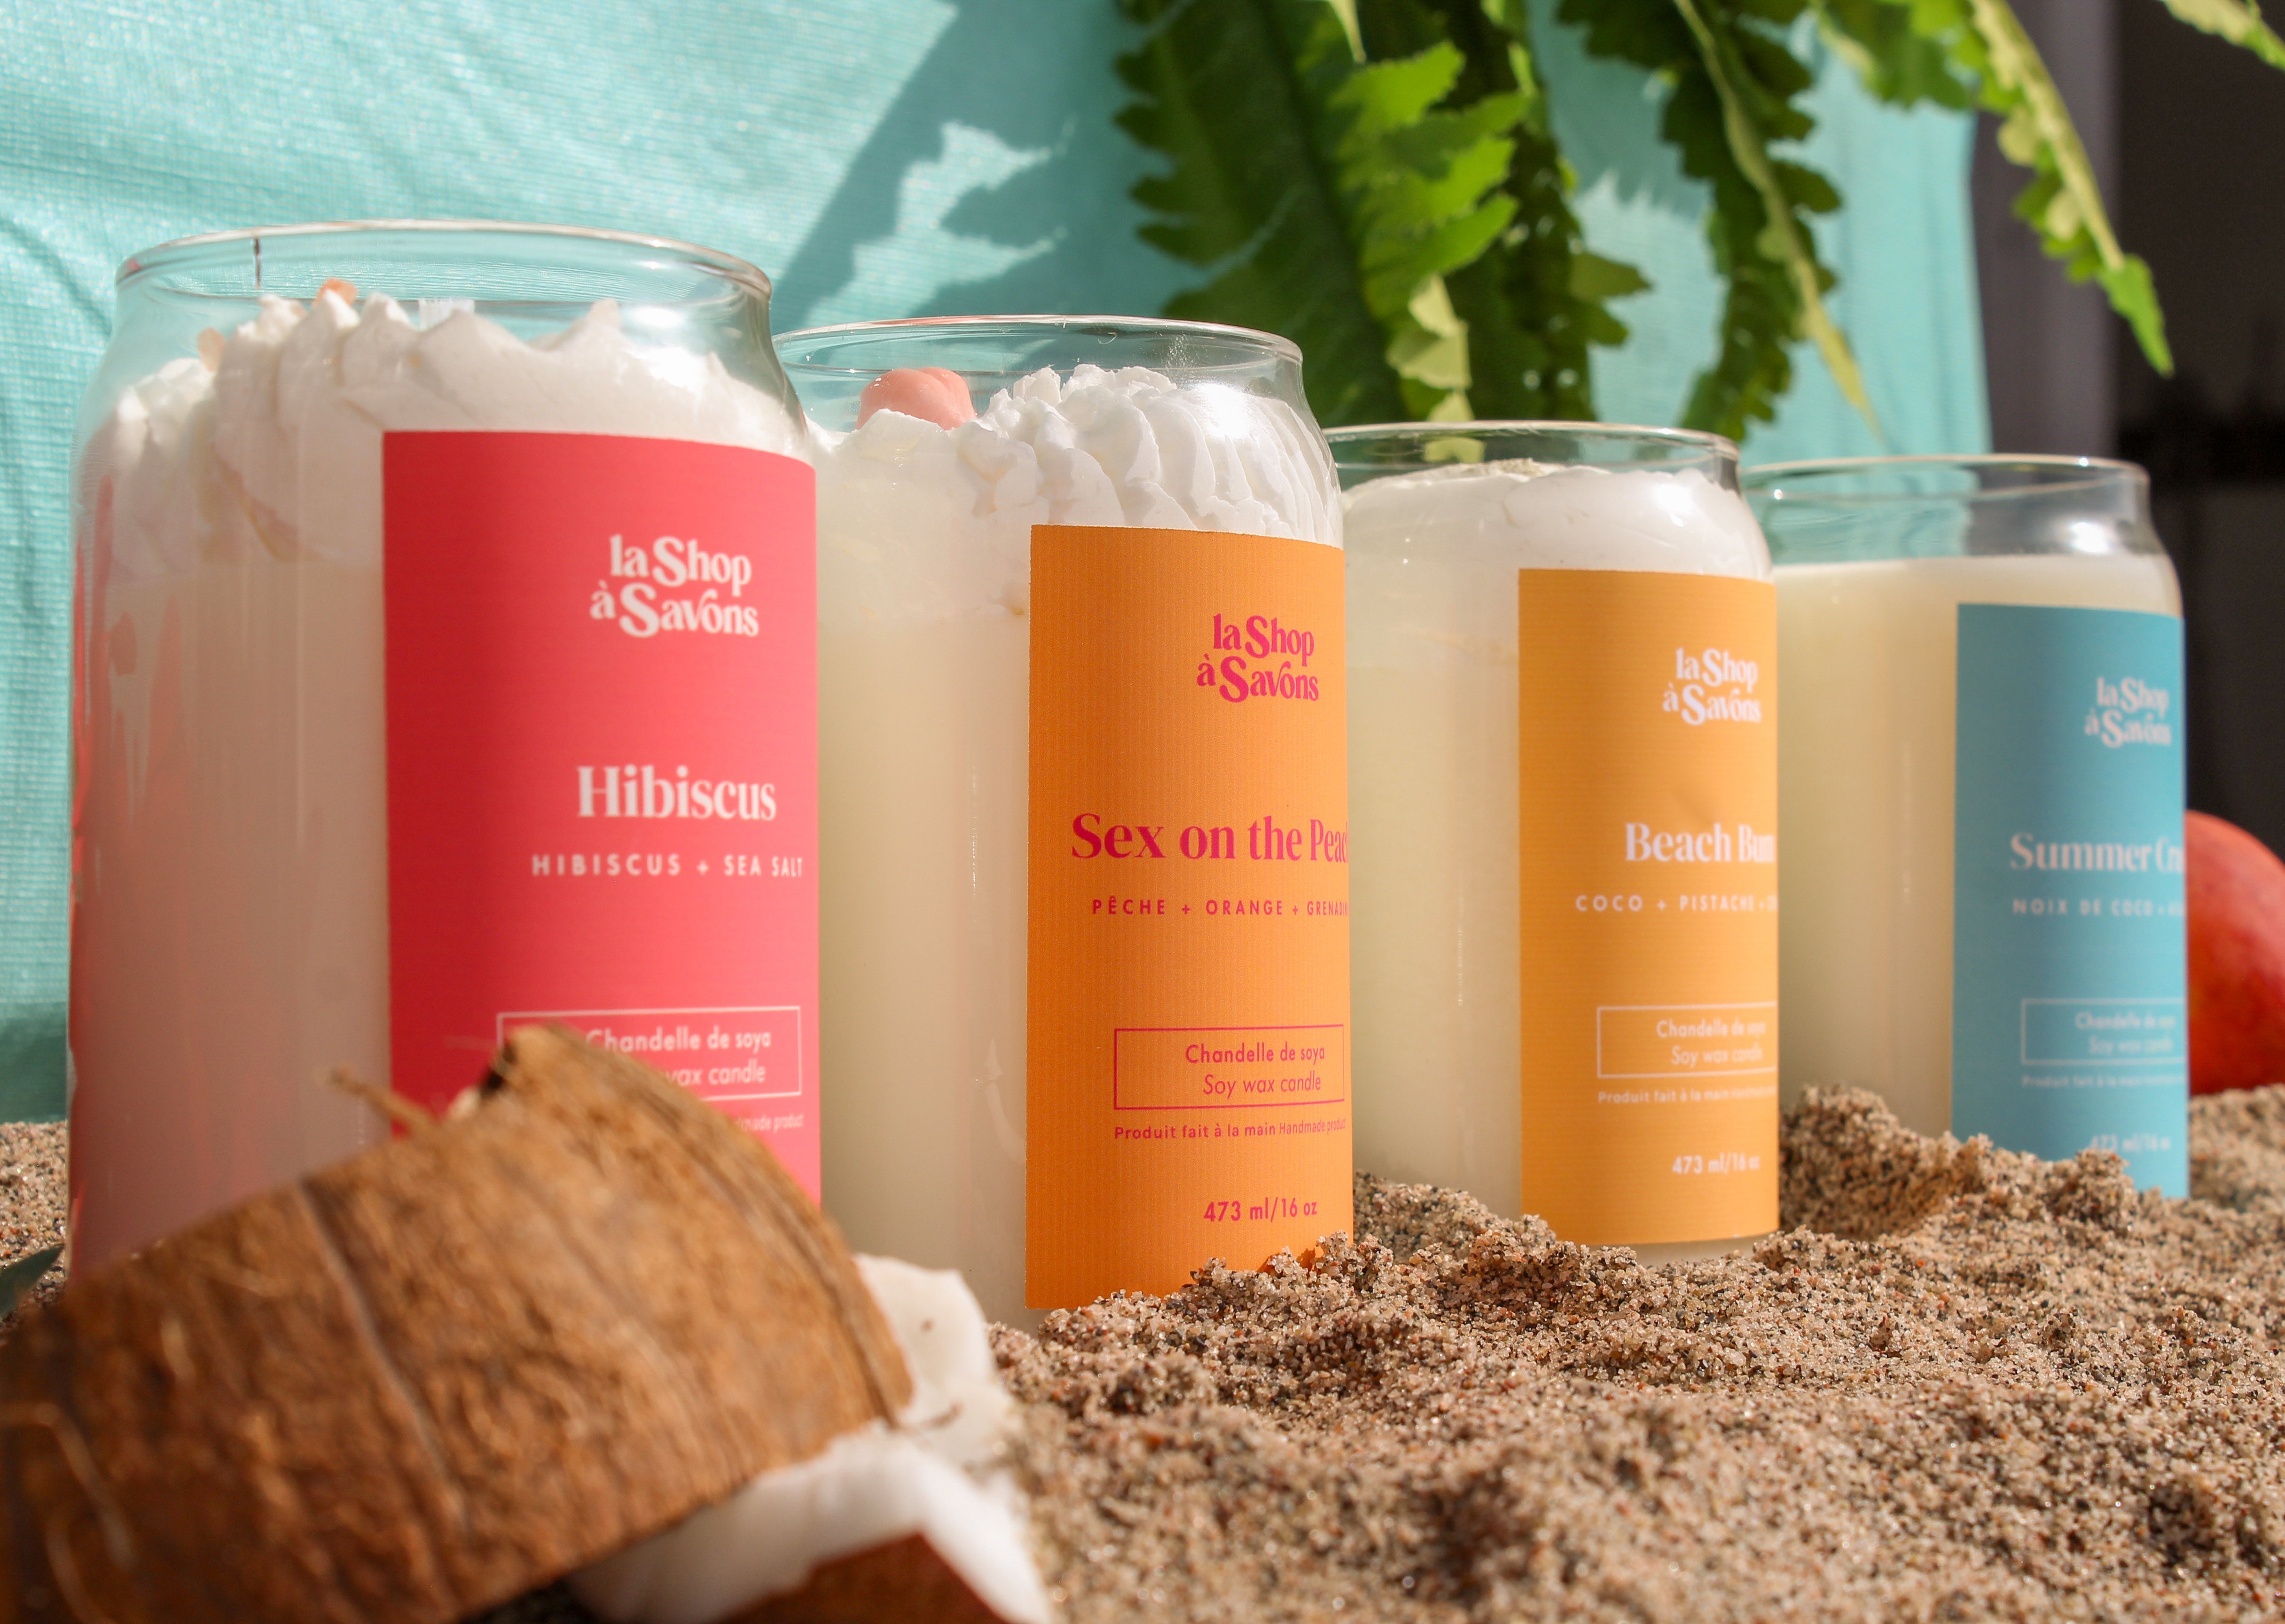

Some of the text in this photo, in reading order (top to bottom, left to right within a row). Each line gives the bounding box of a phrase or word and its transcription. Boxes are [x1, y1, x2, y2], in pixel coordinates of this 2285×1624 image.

[610, 534, 751, 597] la Shop
[589, 579, 759, 638] à Savons
[1213, 613, 1315, 666] la Shop
[1196, 654, 1318, 703] à Savons
[1675, 647, 1758, 693] la Shop
[1662, 682, 1761, 726] à Savons
[2097, 677, 2169, 719] la Shop
[2084, 708, 2173, 748] à Savons
[577, 765, 776, 821] Hibiscus
[1072, 813, 1166, 859] Sex
[1179, 825, 1236, 860] on
[1248, 815, 1302, 861] the
[1625, 822, 1732, 862] Beach
[532, 853, 681, 876] HIBISCUS
[724, 855, 761, 876] SEA
[772, 857, 803, 877] SALT
[2011, 833, 2152, 872] Summer
[1092, 896, 1166, 914] PÊCHE
[1205, 899, 1283, 915] ORANGE
[1307, 900, 1349, 916] GRENADIN
[1576, 895, 1643, 912] COCO
[1679, 895, 1754, 912] PISTACHE
[2013, 898, 2067, 915] NOIX
[2080, 899, 2101, 916] DE
[2112, 899, 2153, 916] COCO
[707, 1026, 729, 1049] de
[736, 1029, 771, 1053] soya
[1656, 1018, 1728, 1038] Chandelle
[1731, 1017, 1744, 1033] de
[1185, 1041, 1325, 1065] Chandelle de soya
[1671, 1045, 1699, 1068] Soy
[1703, 1049, 1728, 1063] wax
[709, 1059, 767, 1085] candle
[1203, 1070, 1321, 1099] Soy wax candle
[1598, 1091, 1650, 1104] Produit
[1653, 1089, 1677, 1102] fait
[1680, 1088, 1688, 1102] à
[774, 1113, 804, 1134] product
[1115, 1118, 1346, 1140] Produit fait à la main Handmade product
[1672, 1154, 1703, 1175] 473
[1708, 1152, 1746, 1174] ml/16
[1204, 1197, 1317, 1222] 473 ml/16 oz
